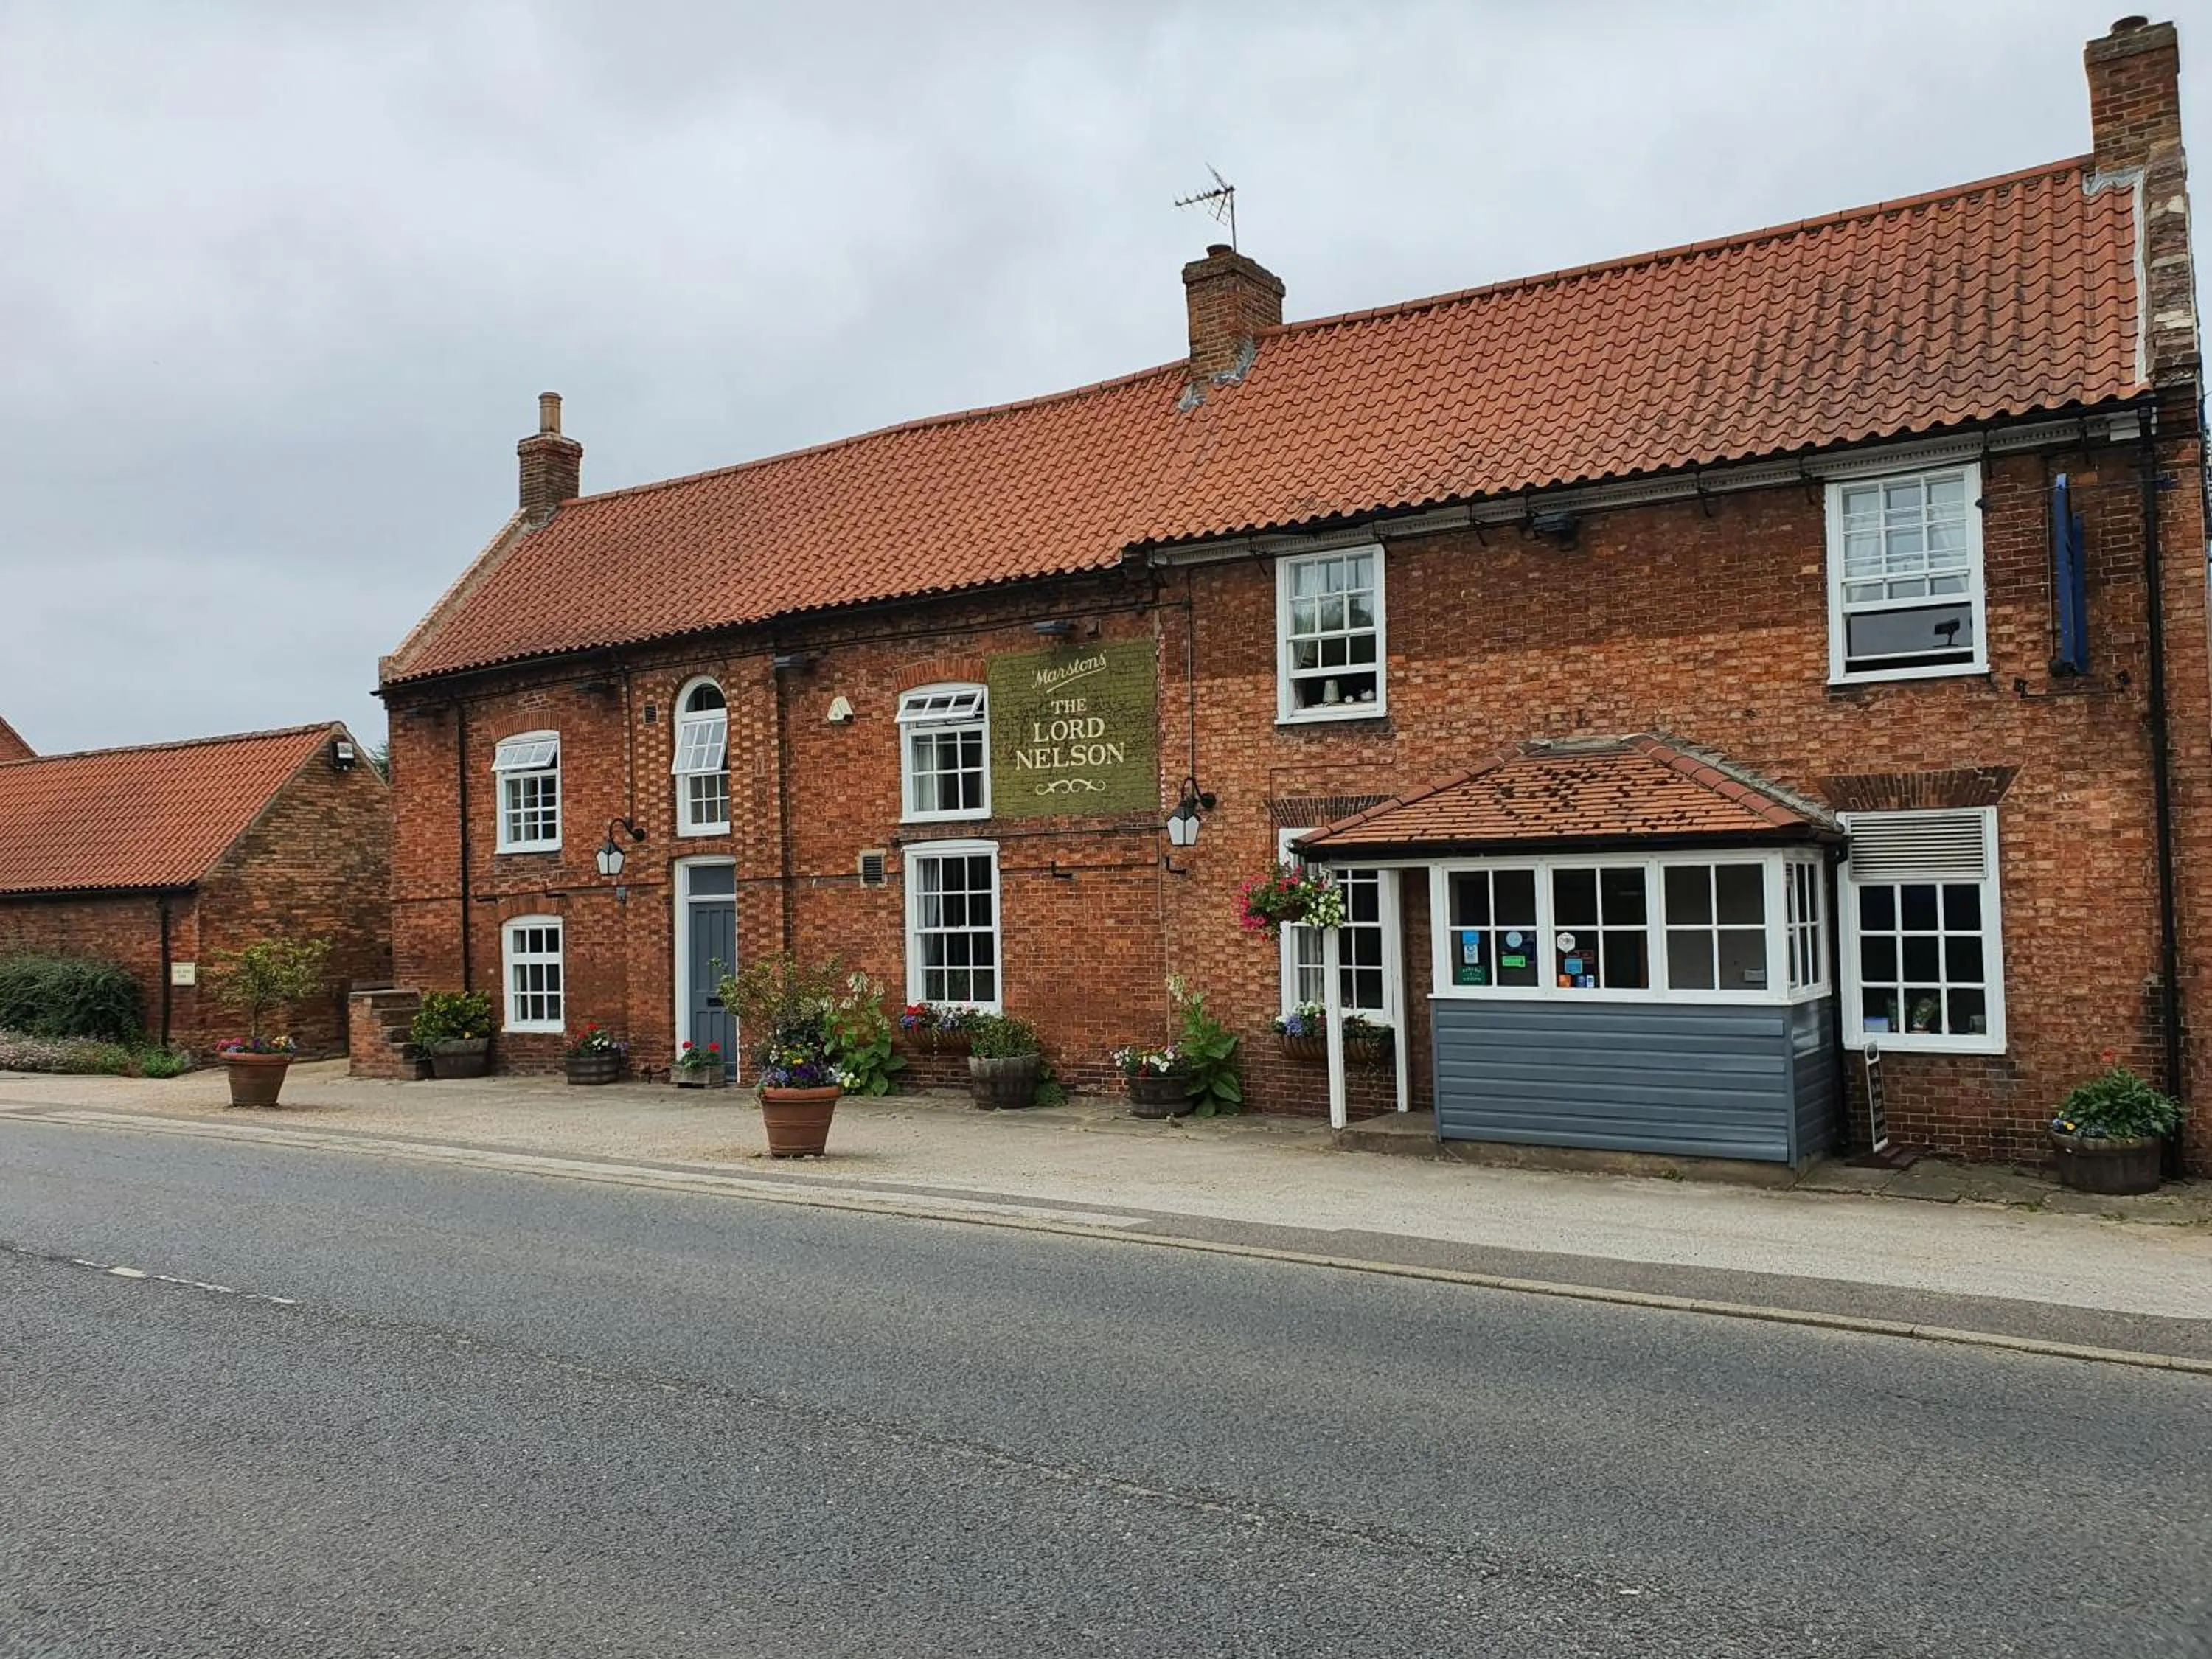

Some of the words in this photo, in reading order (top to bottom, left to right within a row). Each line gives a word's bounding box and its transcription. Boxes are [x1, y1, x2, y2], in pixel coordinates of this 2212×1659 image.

[1051, 698, 1087, 714] THE
[1033, 717, 1105, 742] LORD
[1015, 742, 1124, 771] NELSON
